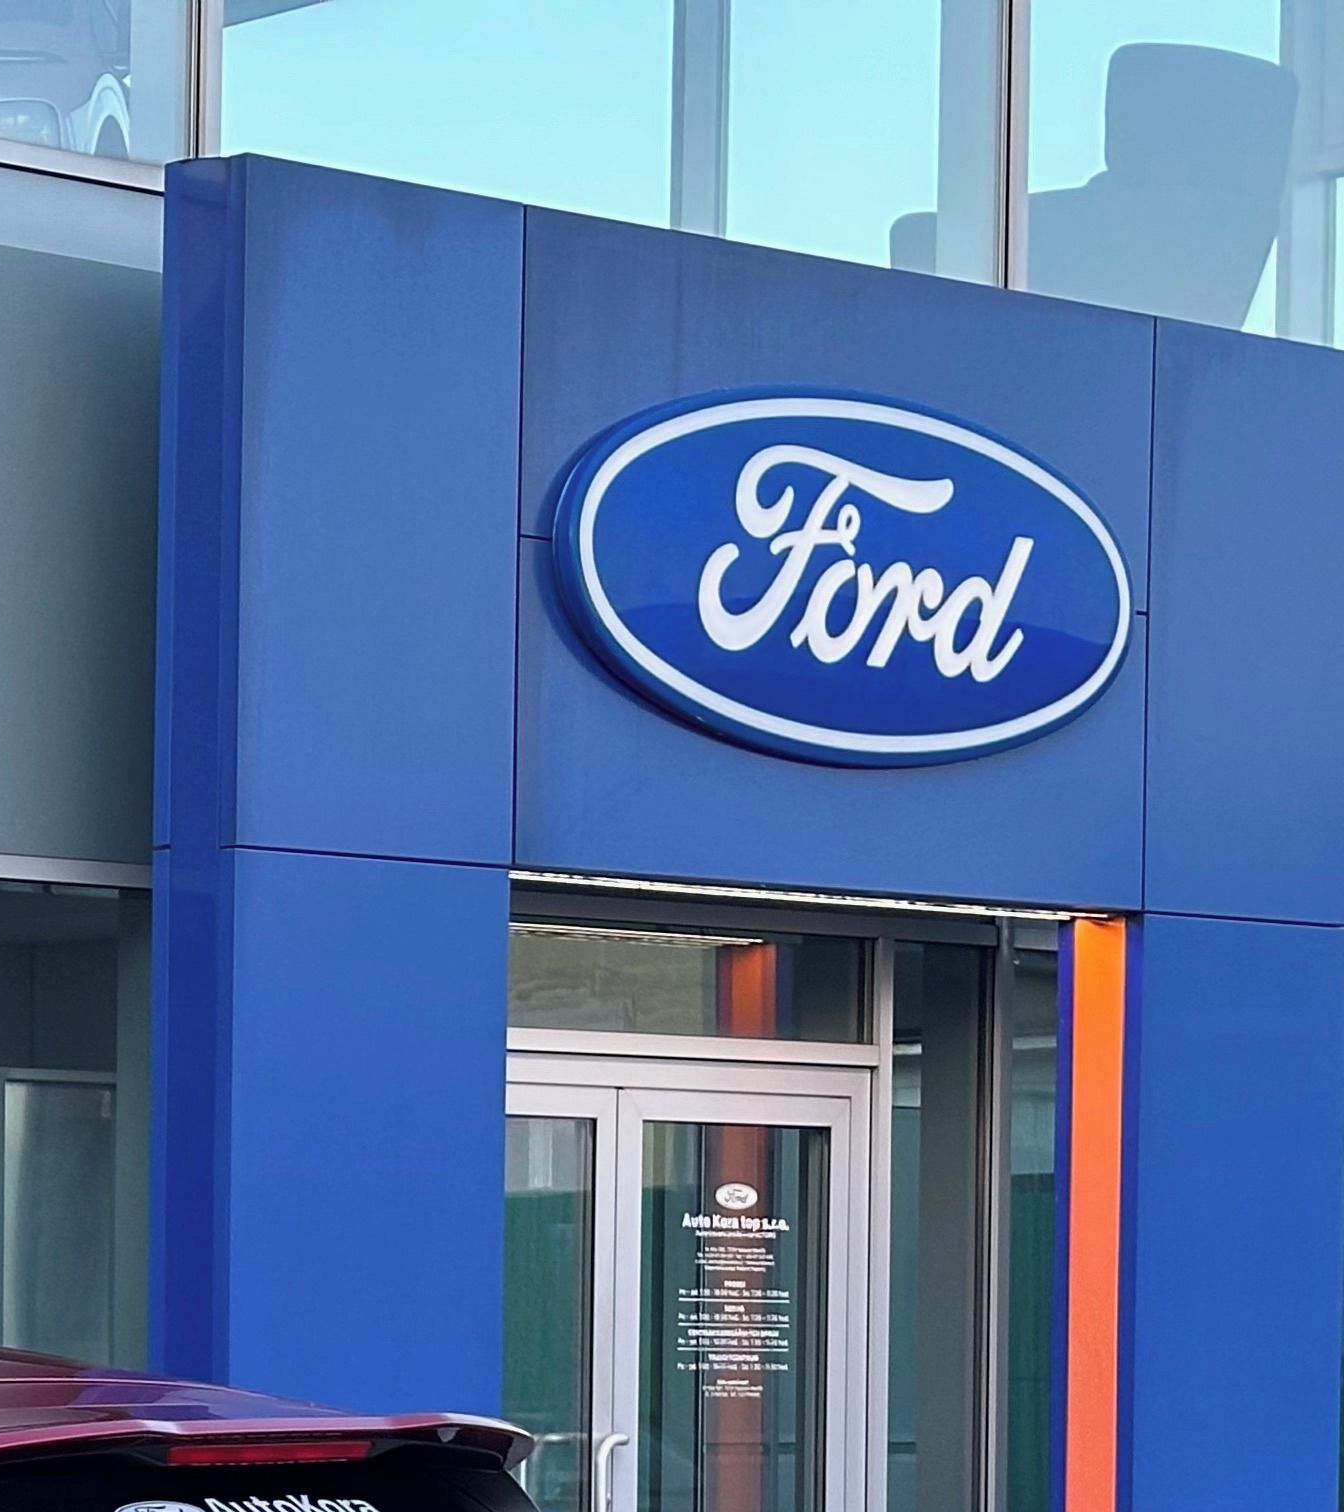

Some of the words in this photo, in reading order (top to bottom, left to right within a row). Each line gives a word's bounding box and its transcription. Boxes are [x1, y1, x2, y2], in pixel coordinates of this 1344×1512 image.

[698, 444, 1034, 682] Ford
[682, 1212, 711, 1228] Auto
[740, 1215, 761, 1232] top
